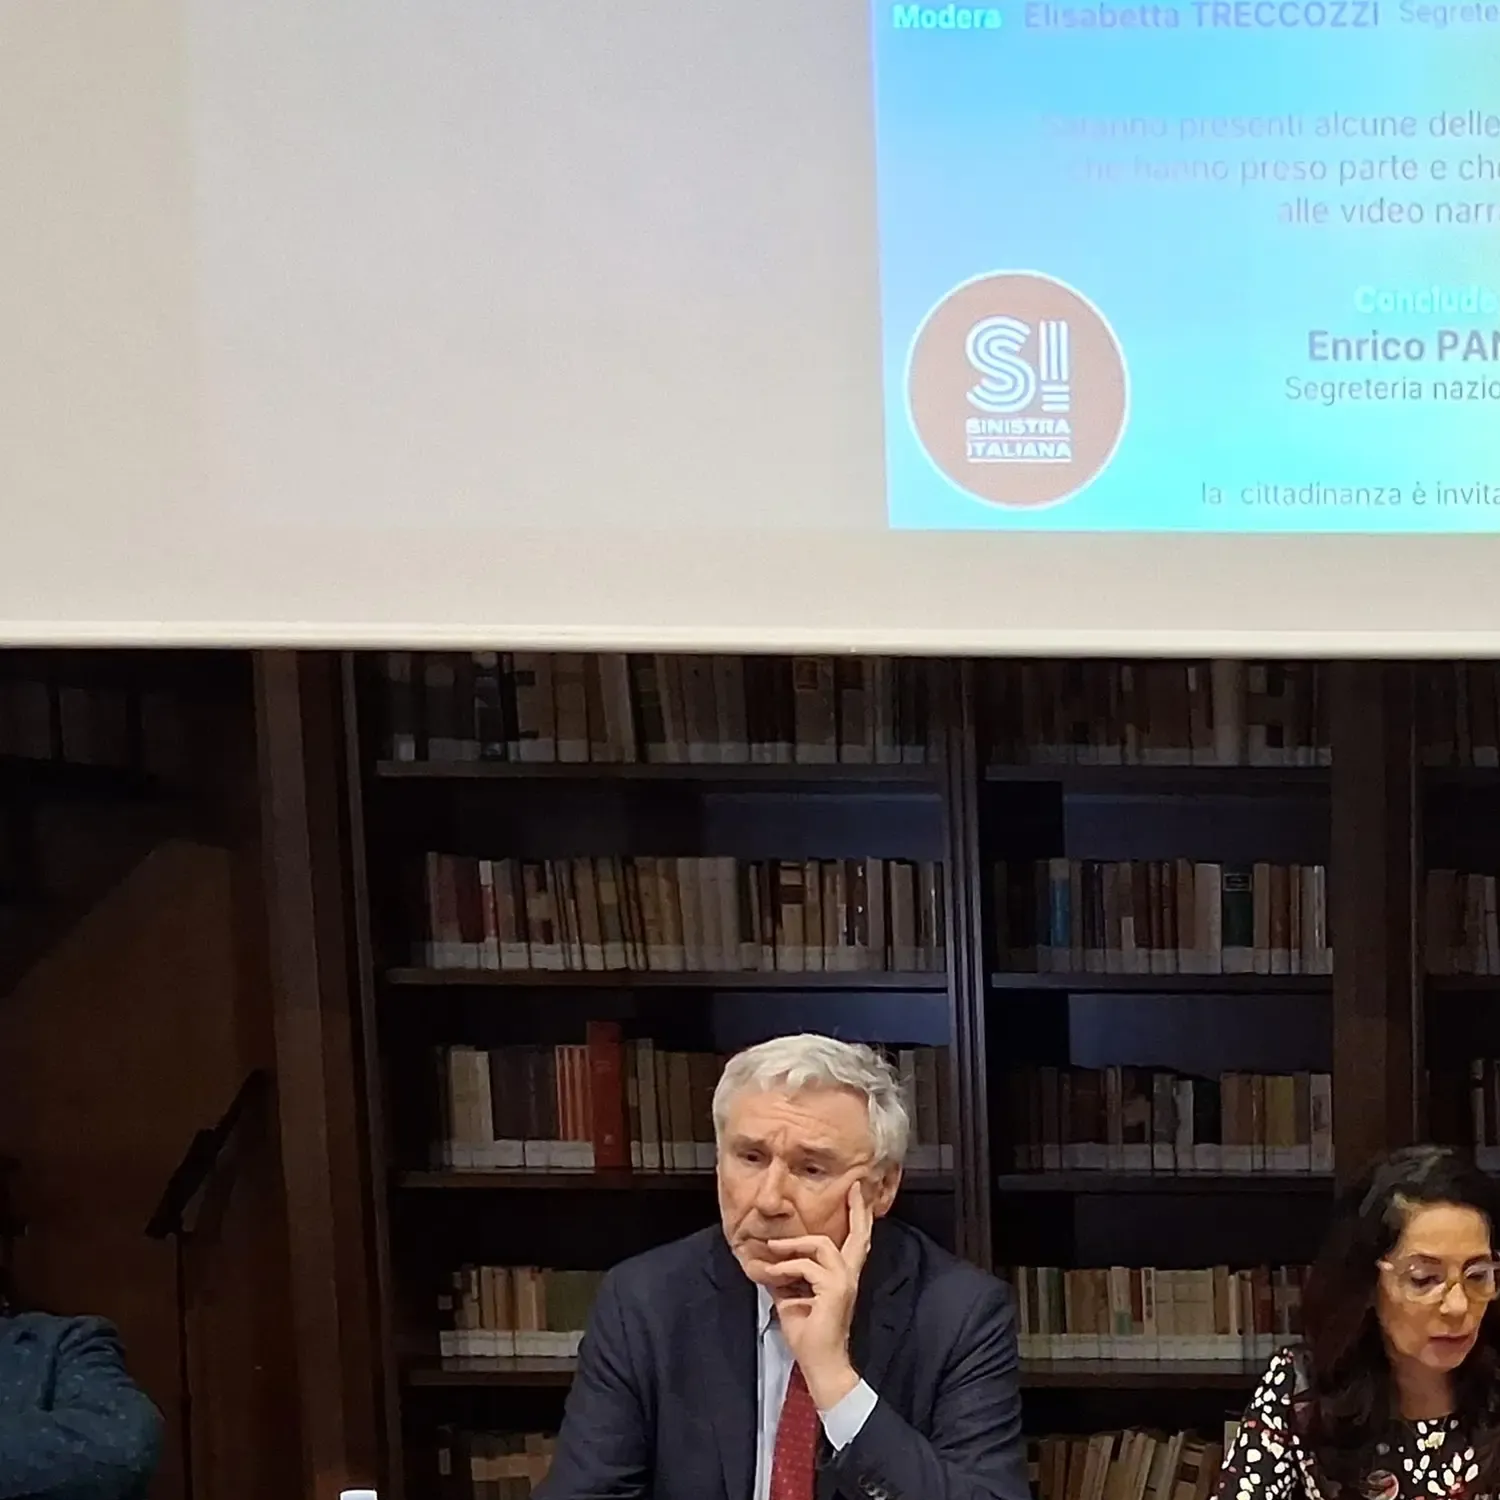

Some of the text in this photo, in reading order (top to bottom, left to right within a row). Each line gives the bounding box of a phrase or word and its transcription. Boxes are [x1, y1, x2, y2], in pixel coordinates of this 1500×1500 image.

[892, 3, 1002, 29] Modera
[1024, 1, 1180, 28] Elisabetta
[1191, 1, 1379, 27] TRECCOZZI
[1180, 113, 1303, 141] presenti
[1314, 111, 1417, 137] alcune
[1428, 110, 1500, 137] delle
[1133, 155, 1230, 181] hanno
[1240, 156, 1327, 186] preso
[1339, 155, 1418, 186] parte
[1430, 159, 1447, 180] e
[1277, 196, 1329, 224] alle
[1340, 196, 1425, 224] video
[1353, 284, 1499, 314] Conclude
[1307, 329, 1426, 362] Enrico
[1284, 376, 1423, 406] Segreteria
[965, 417, 1071, 434] SINISTRA
[966, 441, 1072, 458] ITALIANA
[1201, 481, 1223, 505] la
[1240, 481, 1402, 506] cittadinanza
[1411, 480, 1428, 506] è
